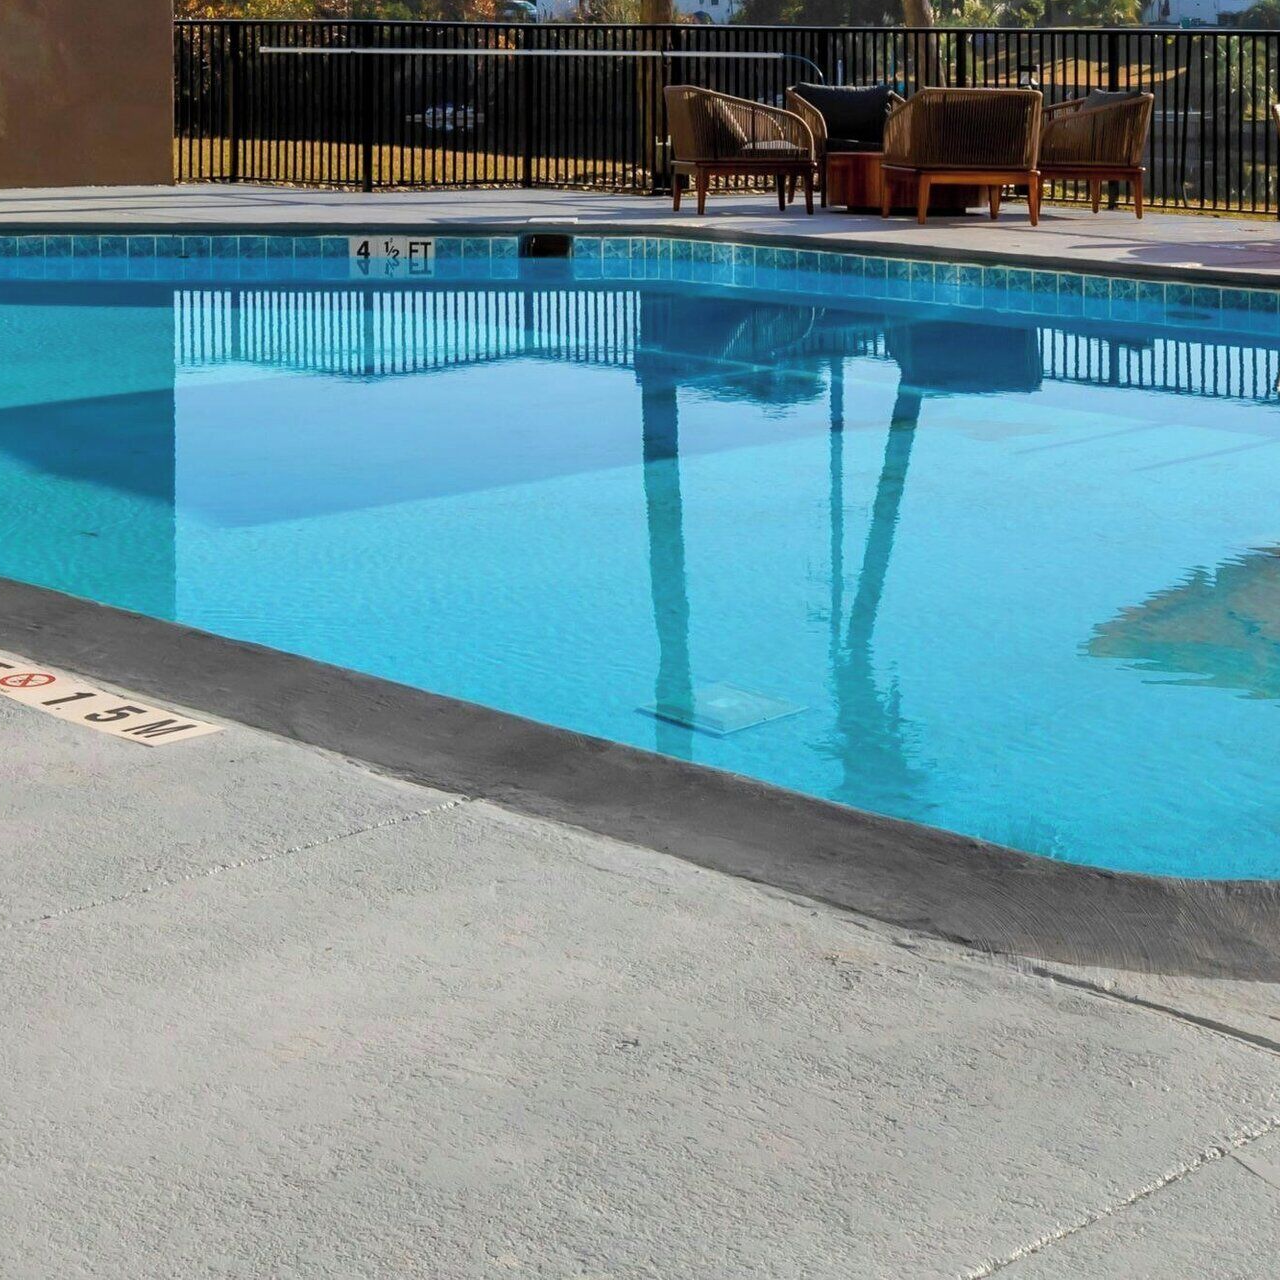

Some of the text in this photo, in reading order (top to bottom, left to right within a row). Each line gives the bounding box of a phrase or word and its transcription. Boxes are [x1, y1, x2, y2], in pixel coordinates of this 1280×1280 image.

[356, 240, 370, 259] 4
[408, 241, 432, 260] FT
[123, 718, 196, 739] M
